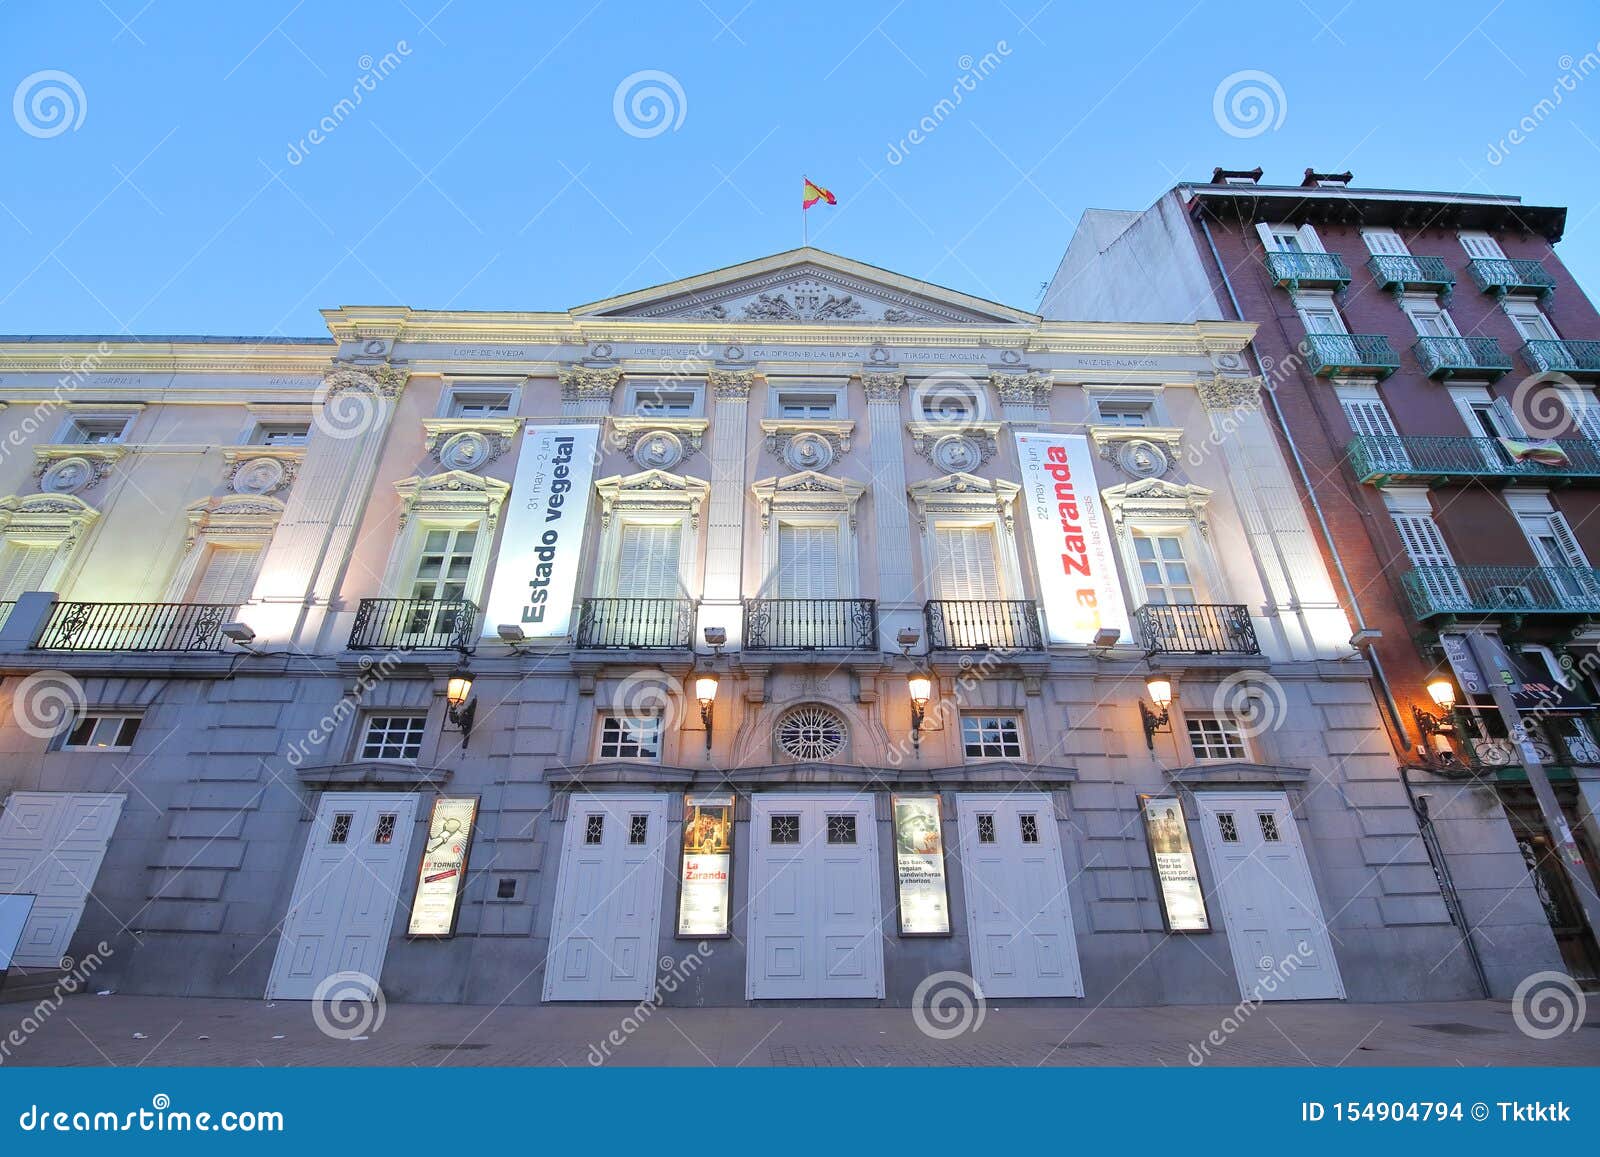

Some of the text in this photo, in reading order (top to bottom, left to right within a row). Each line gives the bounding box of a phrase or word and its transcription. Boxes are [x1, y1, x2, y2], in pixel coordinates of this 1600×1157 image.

[453, 348, 478, 357] LOPE
[480, 349, 492, 357] DE
[634, 348, 658, 356] LOPE
[1028, 447, 1041, 462] jun
[527, 497, 539, 510] 31
[533, 471, 546, 493] may
[541, 437, 551, 452] jun
[1035, 482, 1046, 504] may
[1036, 506, 1049, 520] 22
[521, 529, 559, 624] Estado
[545, 436, 575, 523] vegetal
[1043, 446, 1102, 630] La Zaranda
[686, 860, 699, 870] La
[685, 871, 727, 880] Zaranda
